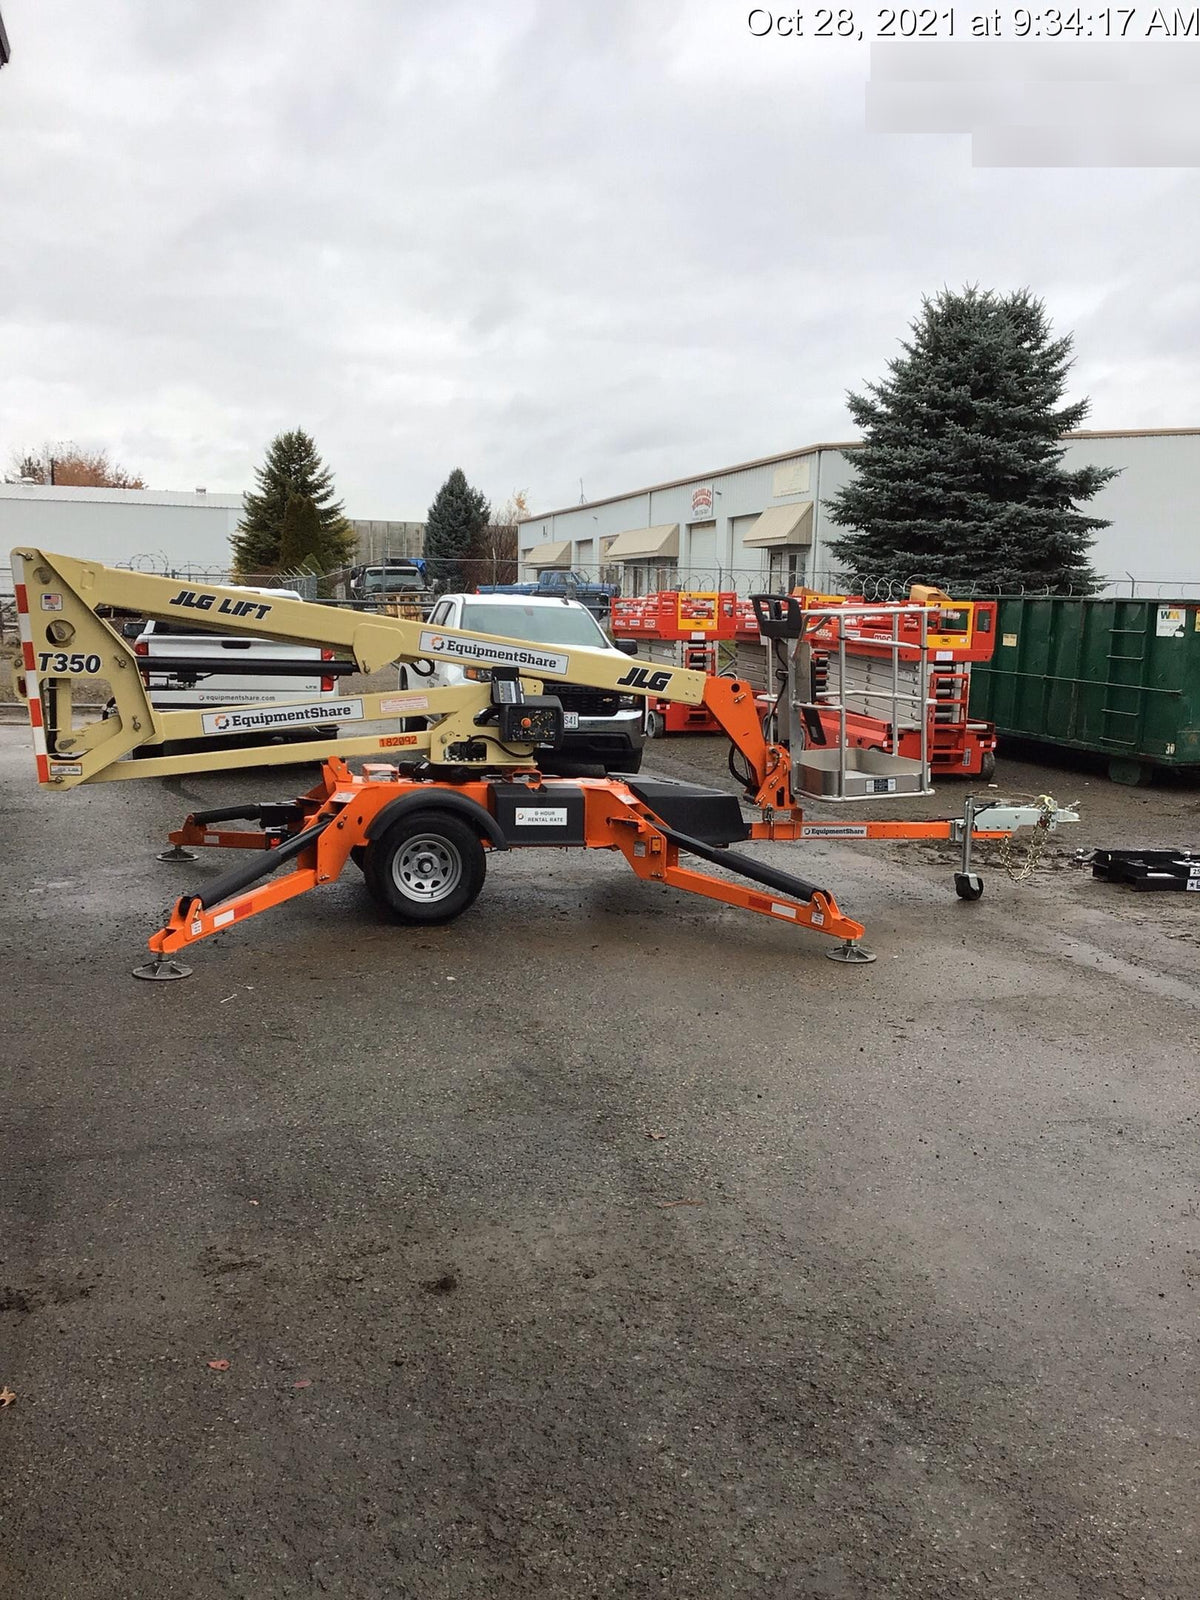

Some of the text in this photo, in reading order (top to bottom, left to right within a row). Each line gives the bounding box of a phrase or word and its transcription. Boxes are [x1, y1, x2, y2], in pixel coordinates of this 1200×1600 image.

[168, 590, 273, 620] JLG LIFT
[37, 652, 102, 674] T350
[446, 639, 558, 669] EquipmentShare
[615, 666, 674, 692] JLG
[205, 694, 276, 702] equipmentshare.com
[231, 704, 352, 728] EquipmentShare
[811, 827, 865, 836] EquipmentShare
